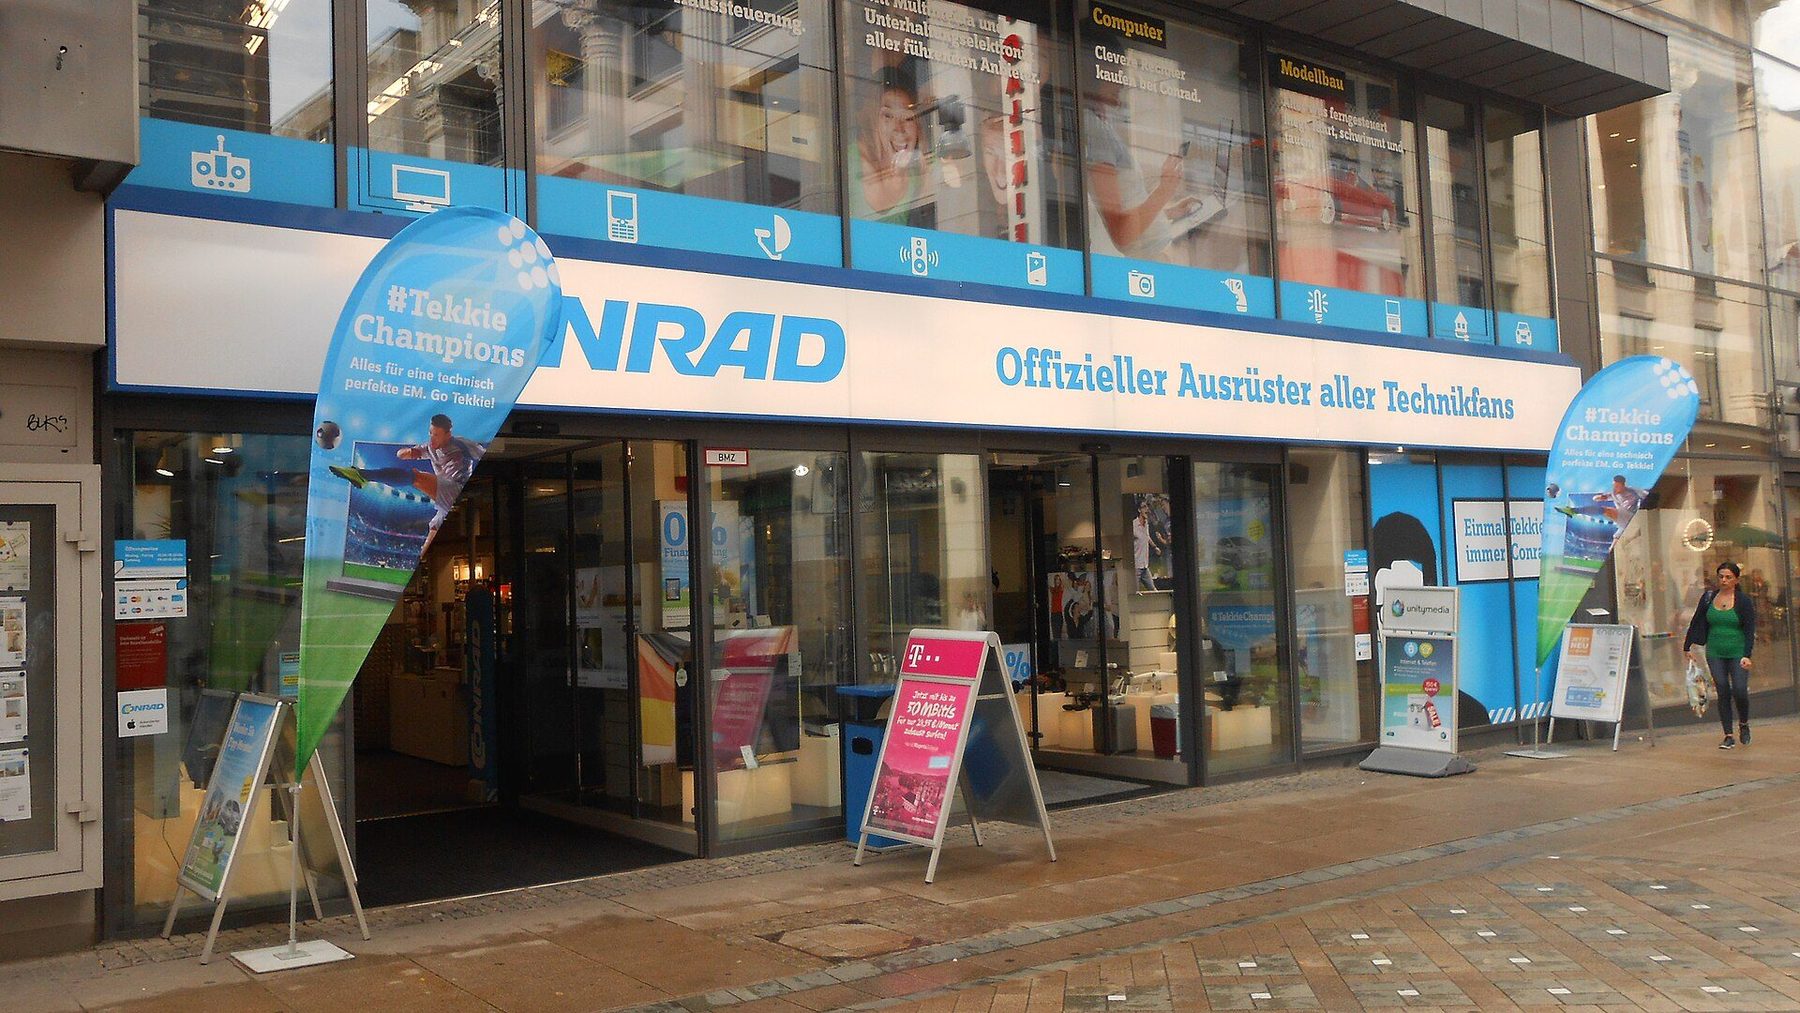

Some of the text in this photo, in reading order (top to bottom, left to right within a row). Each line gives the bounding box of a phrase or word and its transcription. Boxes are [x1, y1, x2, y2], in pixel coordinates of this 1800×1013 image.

[1093, 7, 1163, 41] Computer
[865, 31, 900, 52] aller
[1096, 64, 1137, 88] kaufen
[1160, 83, 1201, 103] Conrad.
[1280, 58, 1344, 91] Modellbau
[1329, 107, 1388, 133] ferngesteuert
[1340, 128, 1386, 149] schwimmt
[1387, 140, 1404, 153] und
[387, 284, 507, 332] #Tekkie
[354, 314, 525, 367] Champions
[537, 296, 846, 384] NRAD
[350, 356, 494, 390] Alles für eine technisch
[996, 346, 1515, 420] Offizieller Ausrüster aller Technikfans
[344, 377, 495, 409] perfekte EM. Go Tekkie!
[1585, 407, 1661, 426] #Tekkie
[1566, 425, 1674, 447] Champions
[718, 453, 736, 462] BMZ
[1562, 460, 1593, 468] perfekte
[1612, 461, 1624, 469] Go
[1626, 461, 1654, 470] Tekkie!
[1564, 448, 1583, 457] Alles
[1585, 449, 1596, 458] für
[1616, 451, 1653, 460] technisch
[1464, 517, 1507, 537] Einmal
[1466, 545, 1506, 563] immer
[1406, 604, 1450, 616] unitymedia
[121, 703, 165, 715] CONRAD
[907, 701, 921, 716] 50
[1426, 704, 1442, 728] SALE
